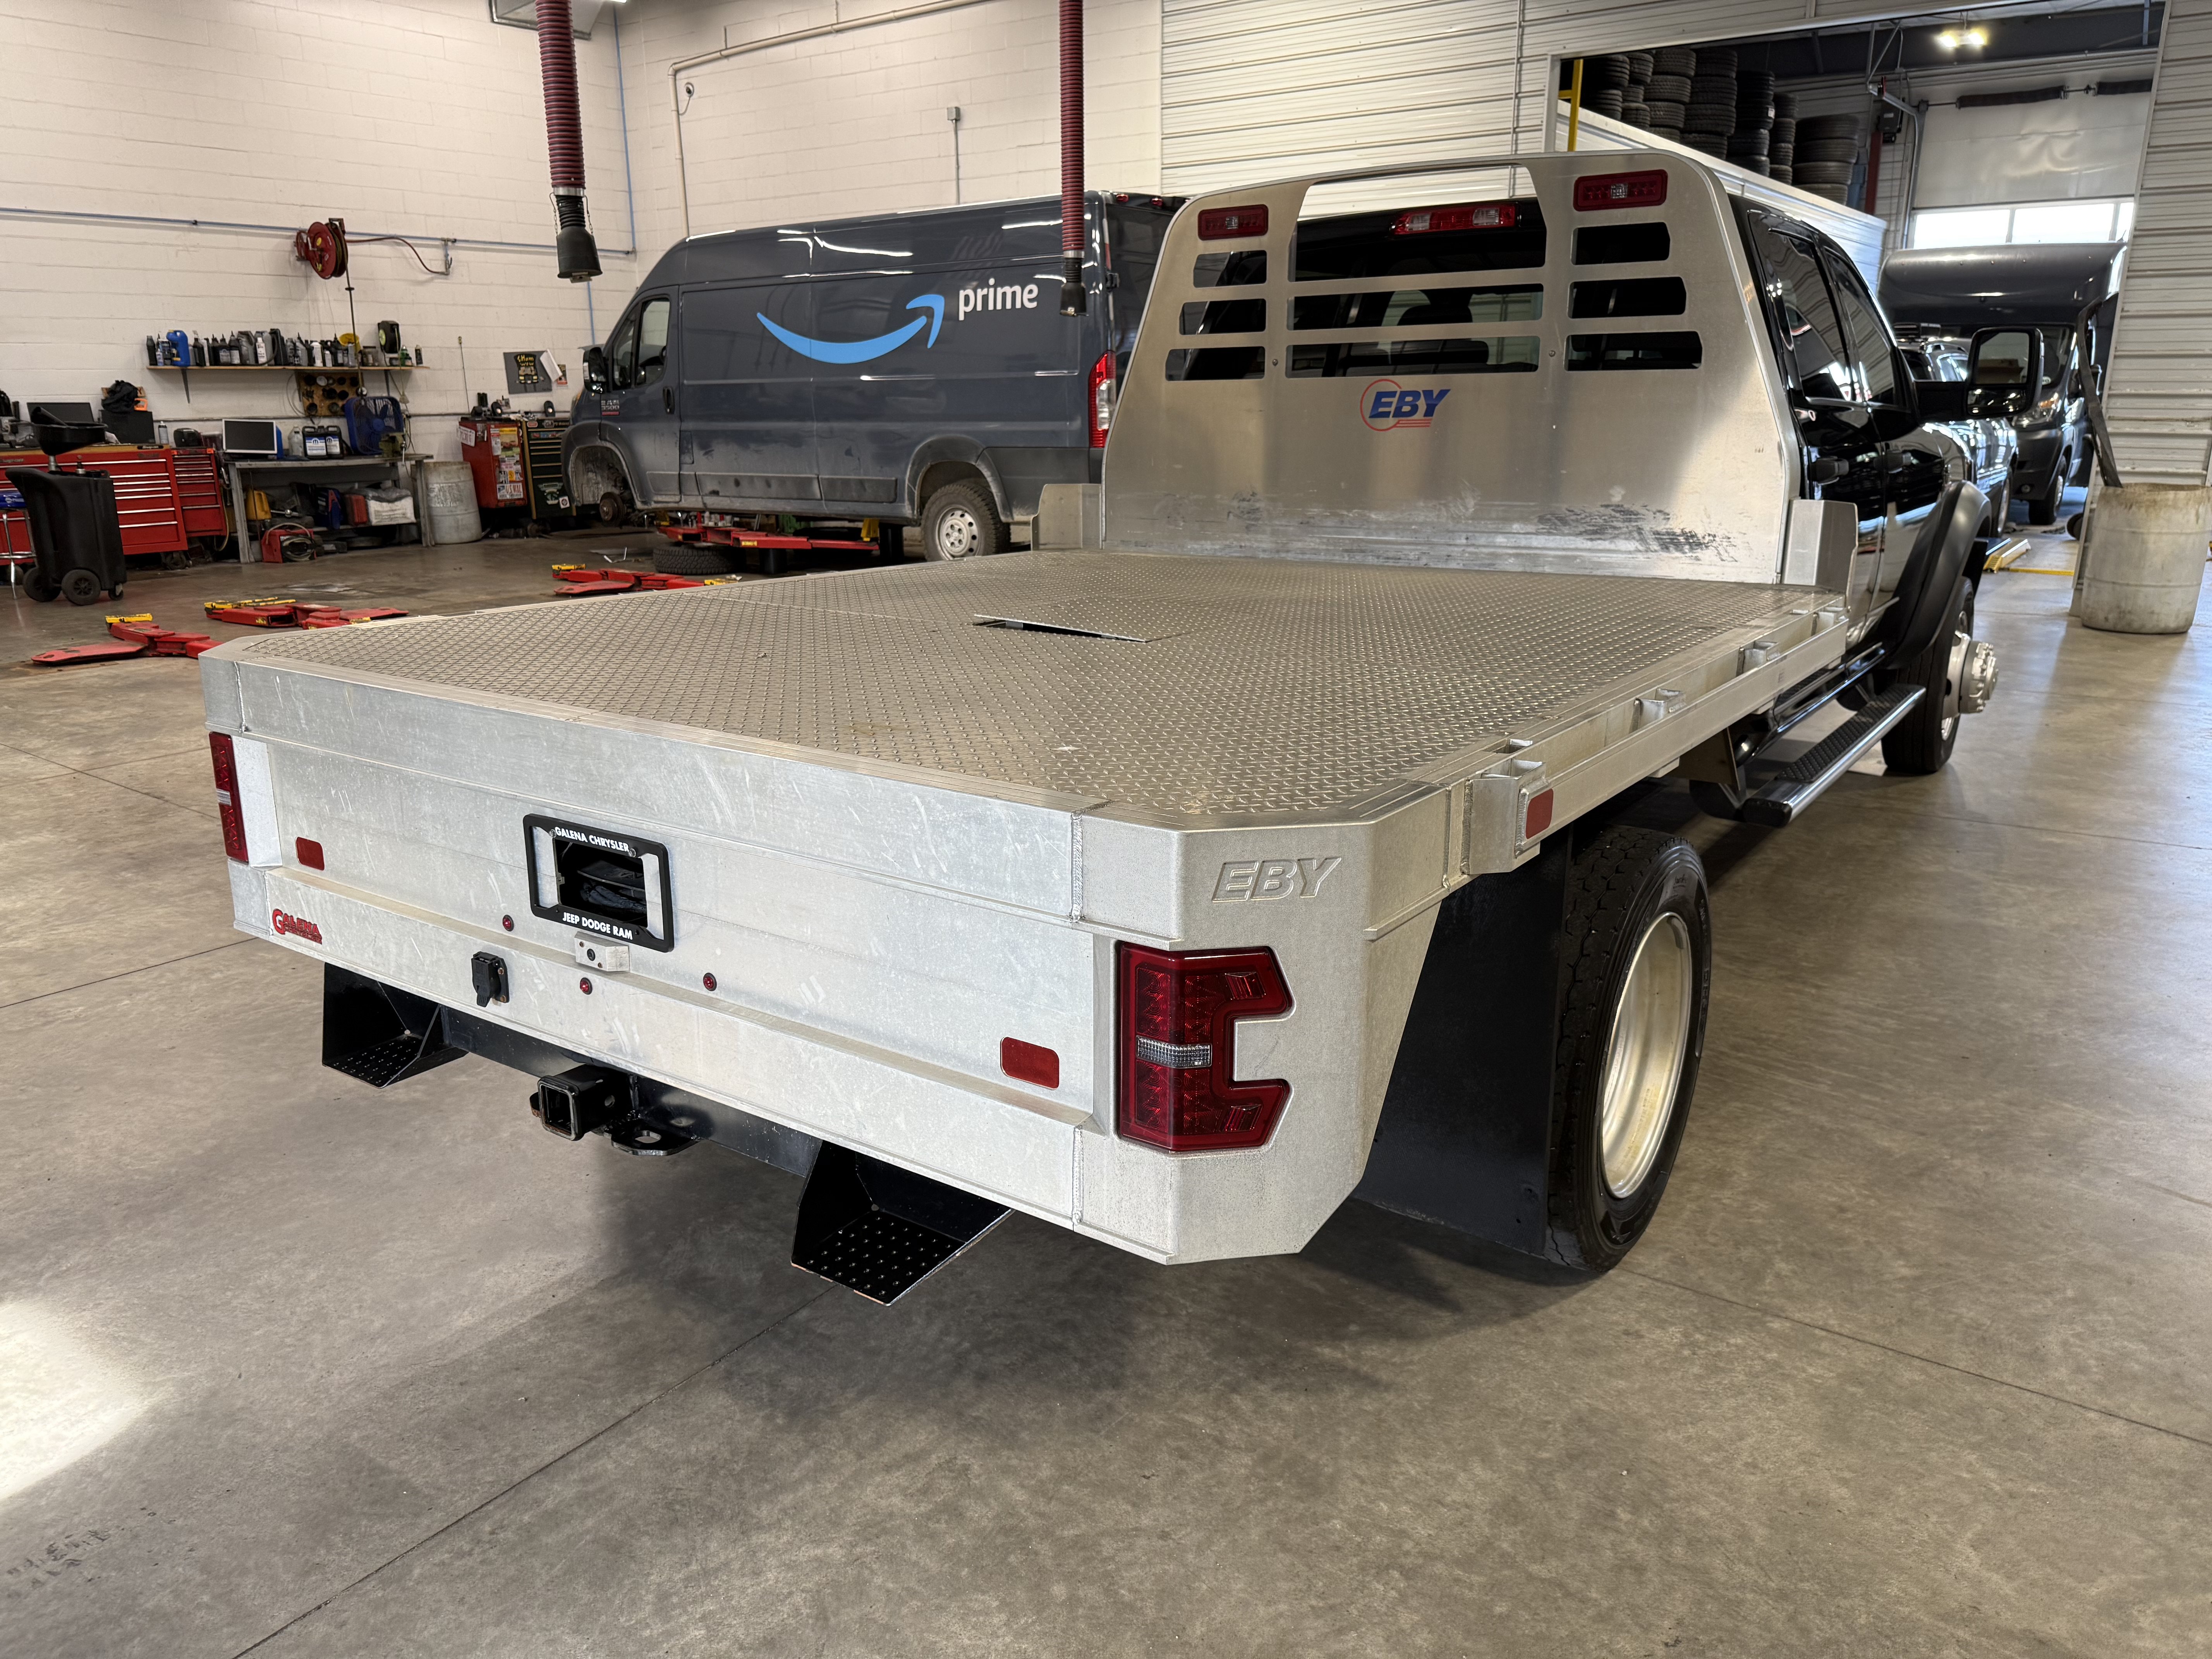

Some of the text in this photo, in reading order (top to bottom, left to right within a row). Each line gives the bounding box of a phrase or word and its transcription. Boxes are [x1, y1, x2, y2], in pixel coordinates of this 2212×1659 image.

[958, 278, 1038, 321] prime
[1369, 389, 1451, 419] EBY
[555, 827, 629, 852] GALENA CHRYSLER
[1212, 857, 1342, 902] EBY
[272, 908, 321, 936] GALENA
[563, 912, 633, 940] JEEP DODGE RAM
